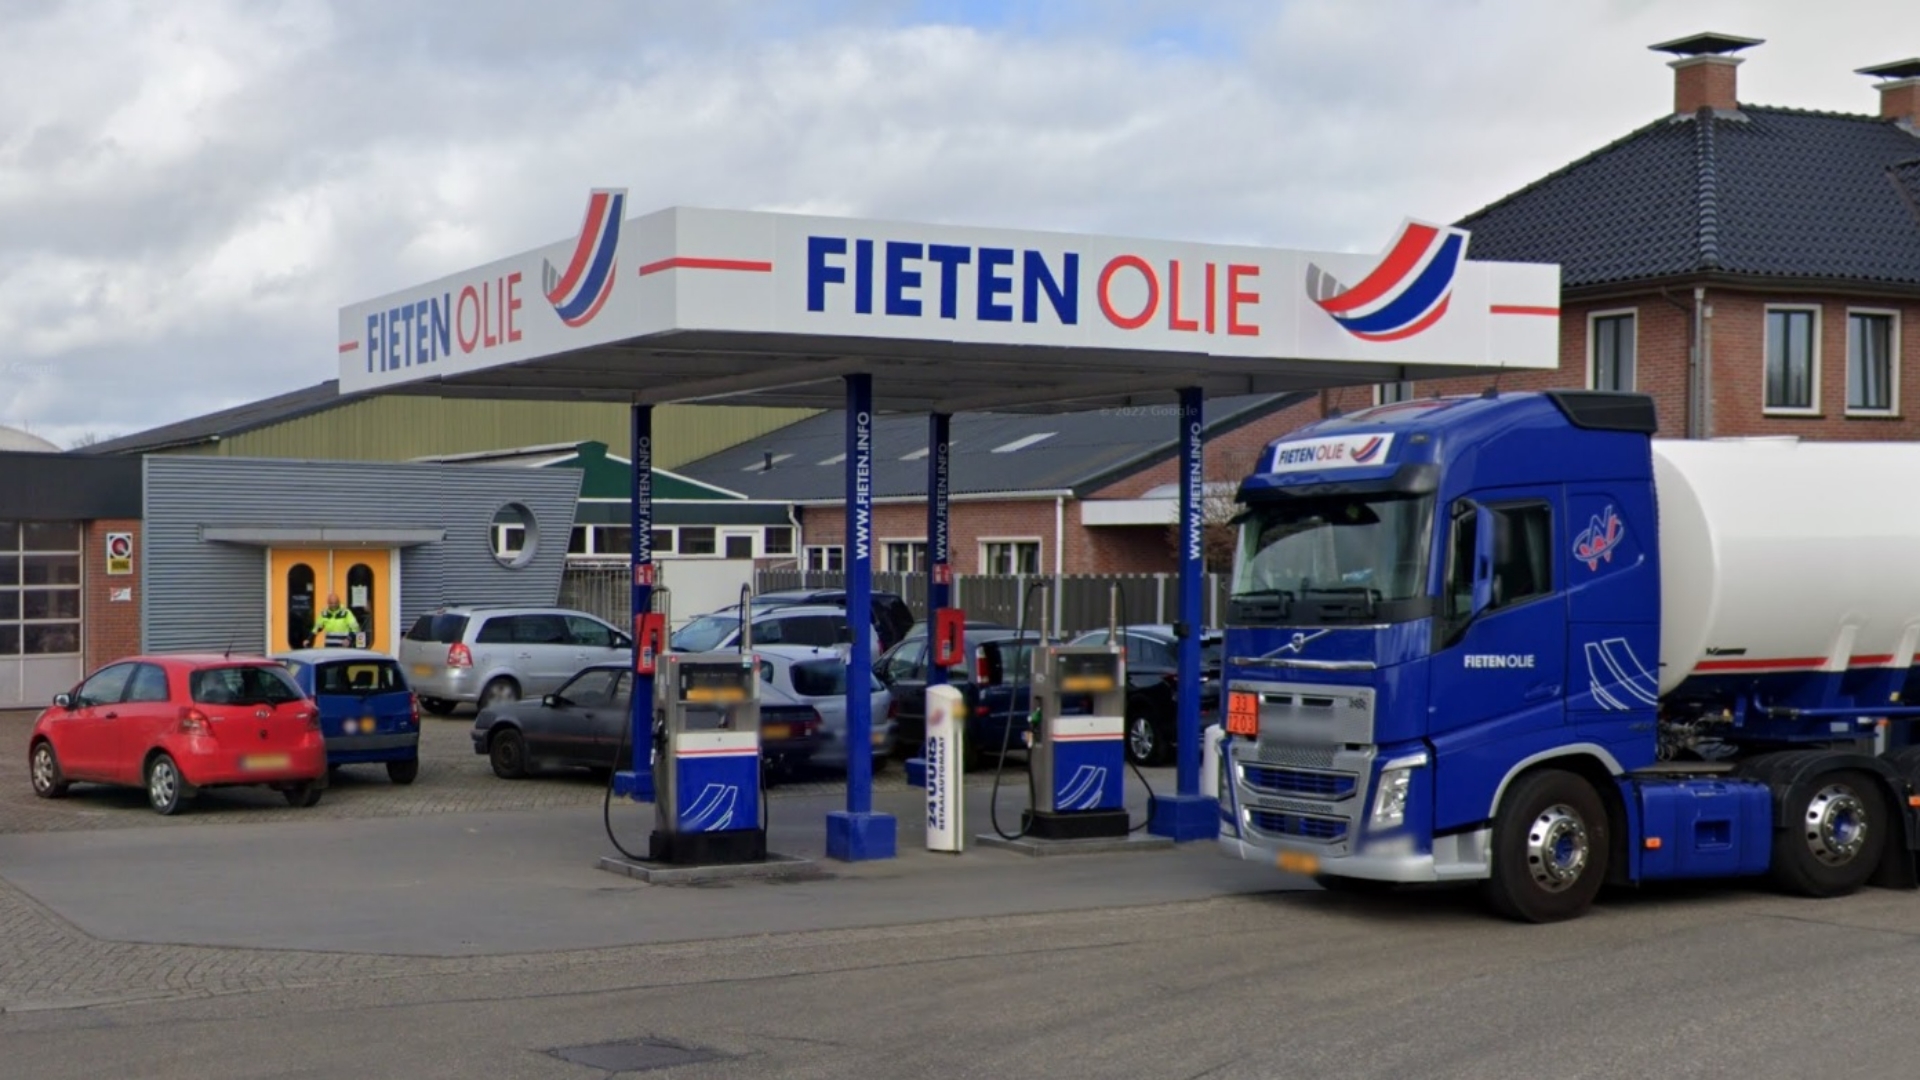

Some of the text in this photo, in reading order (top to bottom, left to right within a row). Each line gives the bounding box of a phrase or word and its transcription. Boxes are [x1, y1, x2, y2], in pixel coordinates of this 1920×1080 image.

[367, 272, 522, 373] FIETEN OLIE
[807, 235, 1259, 336] FIETEN OLIE
[639, 436, 650, 562] WWW.FIETEN.INFO
[857, 411, 869, 560] WWW.FIETEN.INFO
[937, 442, 949, 561] WWW.FIETEN.INFO
[1189, 422, 1201, 561] WWW.FIETEN.INFO
[1278, 443, 1345, 466] FIETEN OLIE
[1235, 695, 1247, 711] 33
[1464, 654, 1535, 669] FIETEN OLIE
[1229, 715, 1255, 732] 1203
[928, 736, 937, 828] 24 UURS
